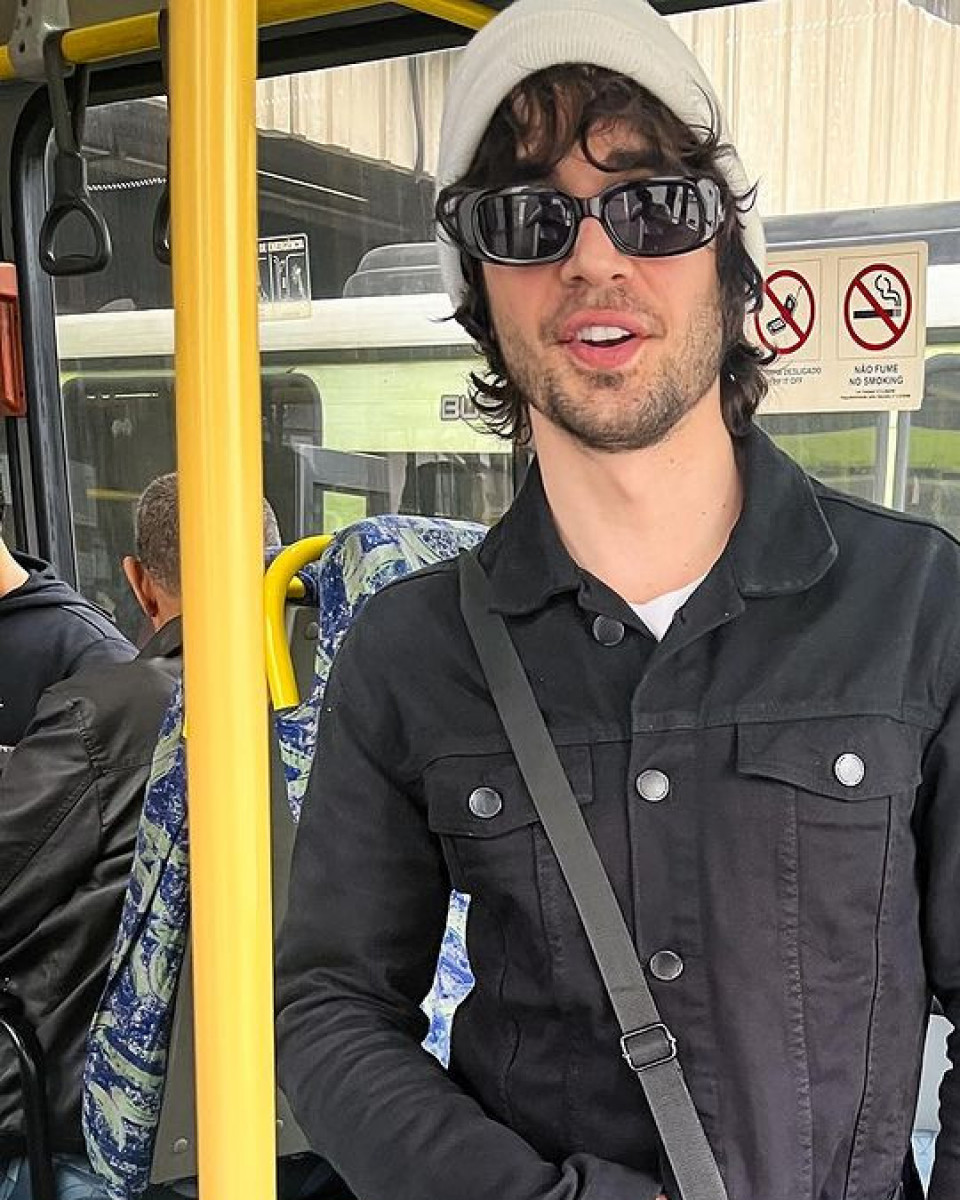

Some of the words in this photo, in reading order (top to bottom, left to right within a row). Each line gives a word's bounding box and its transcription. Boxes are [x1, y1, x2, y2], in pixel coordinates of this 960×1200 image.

[875, 363, 898, 374] FUME
[849, 376, 862, 387] NO
[864, 375, 904, 387] SMOKING
